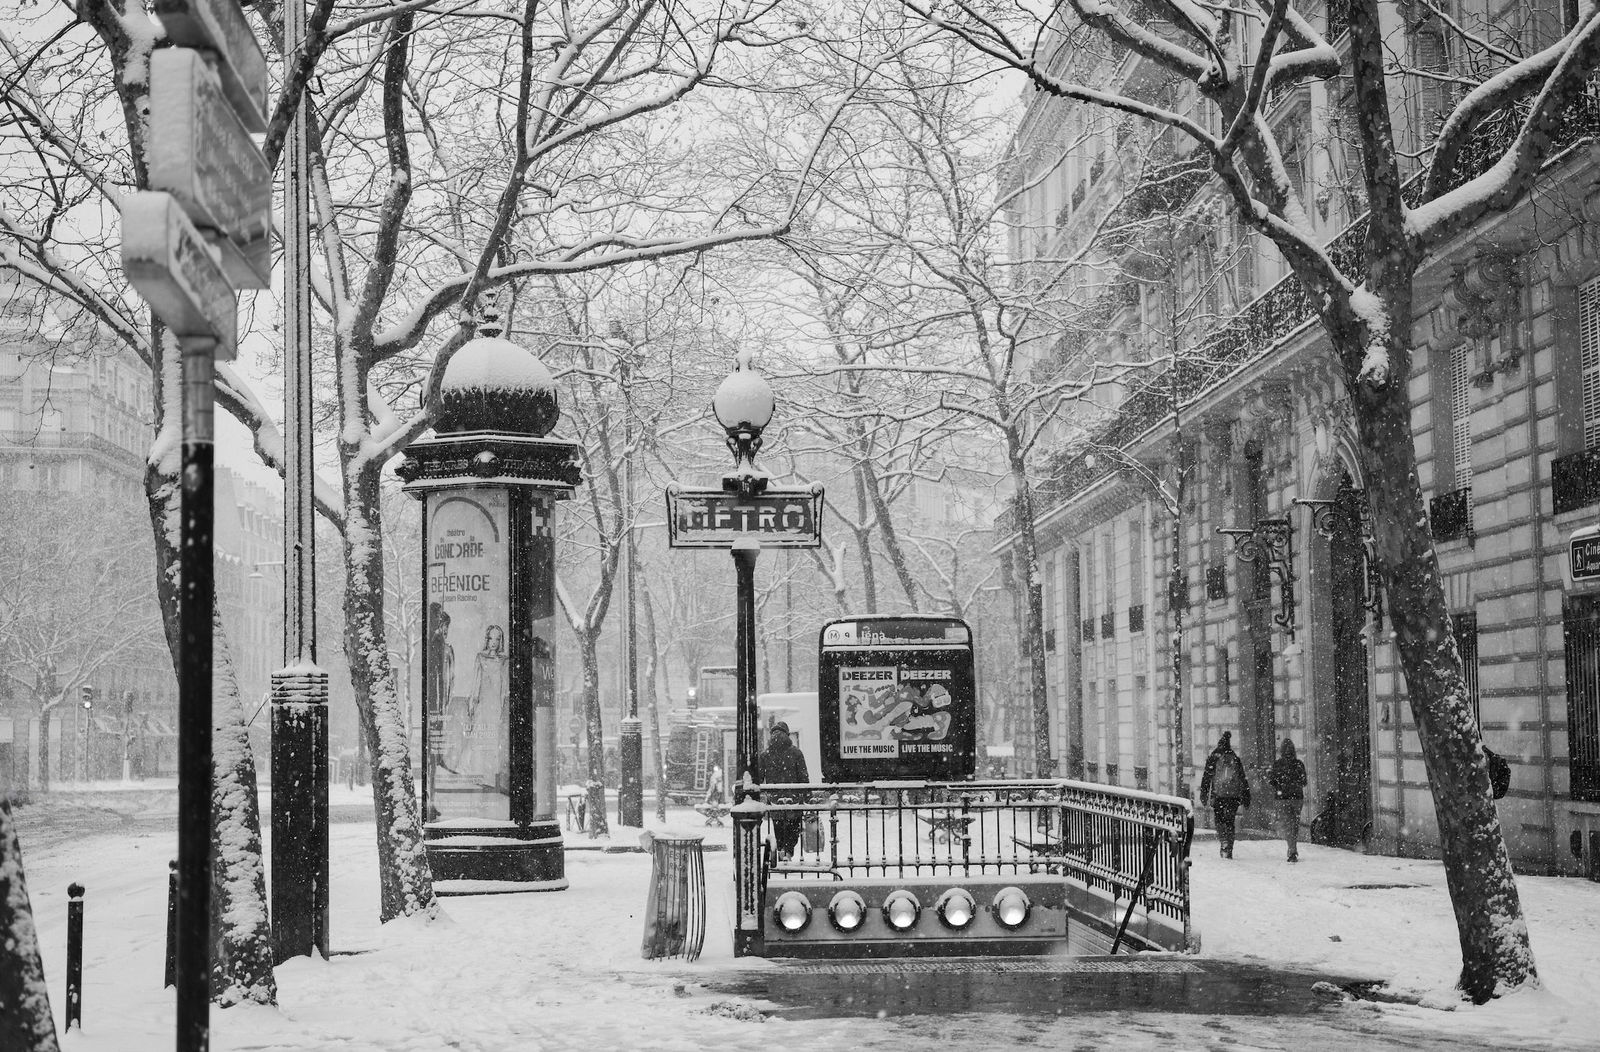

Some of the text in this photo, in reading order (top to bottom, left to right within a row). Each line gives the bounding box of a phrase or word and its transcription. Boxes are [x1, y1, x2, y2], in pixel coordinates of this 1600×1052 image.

[842, 671, 893, 681] DEEZER
[900, 670, 952, 680] DEEZER
[843, 744, 895, 754] LIVE THE MUSIC
[901, 743, 954, 753] LIVE THE MUSIC
